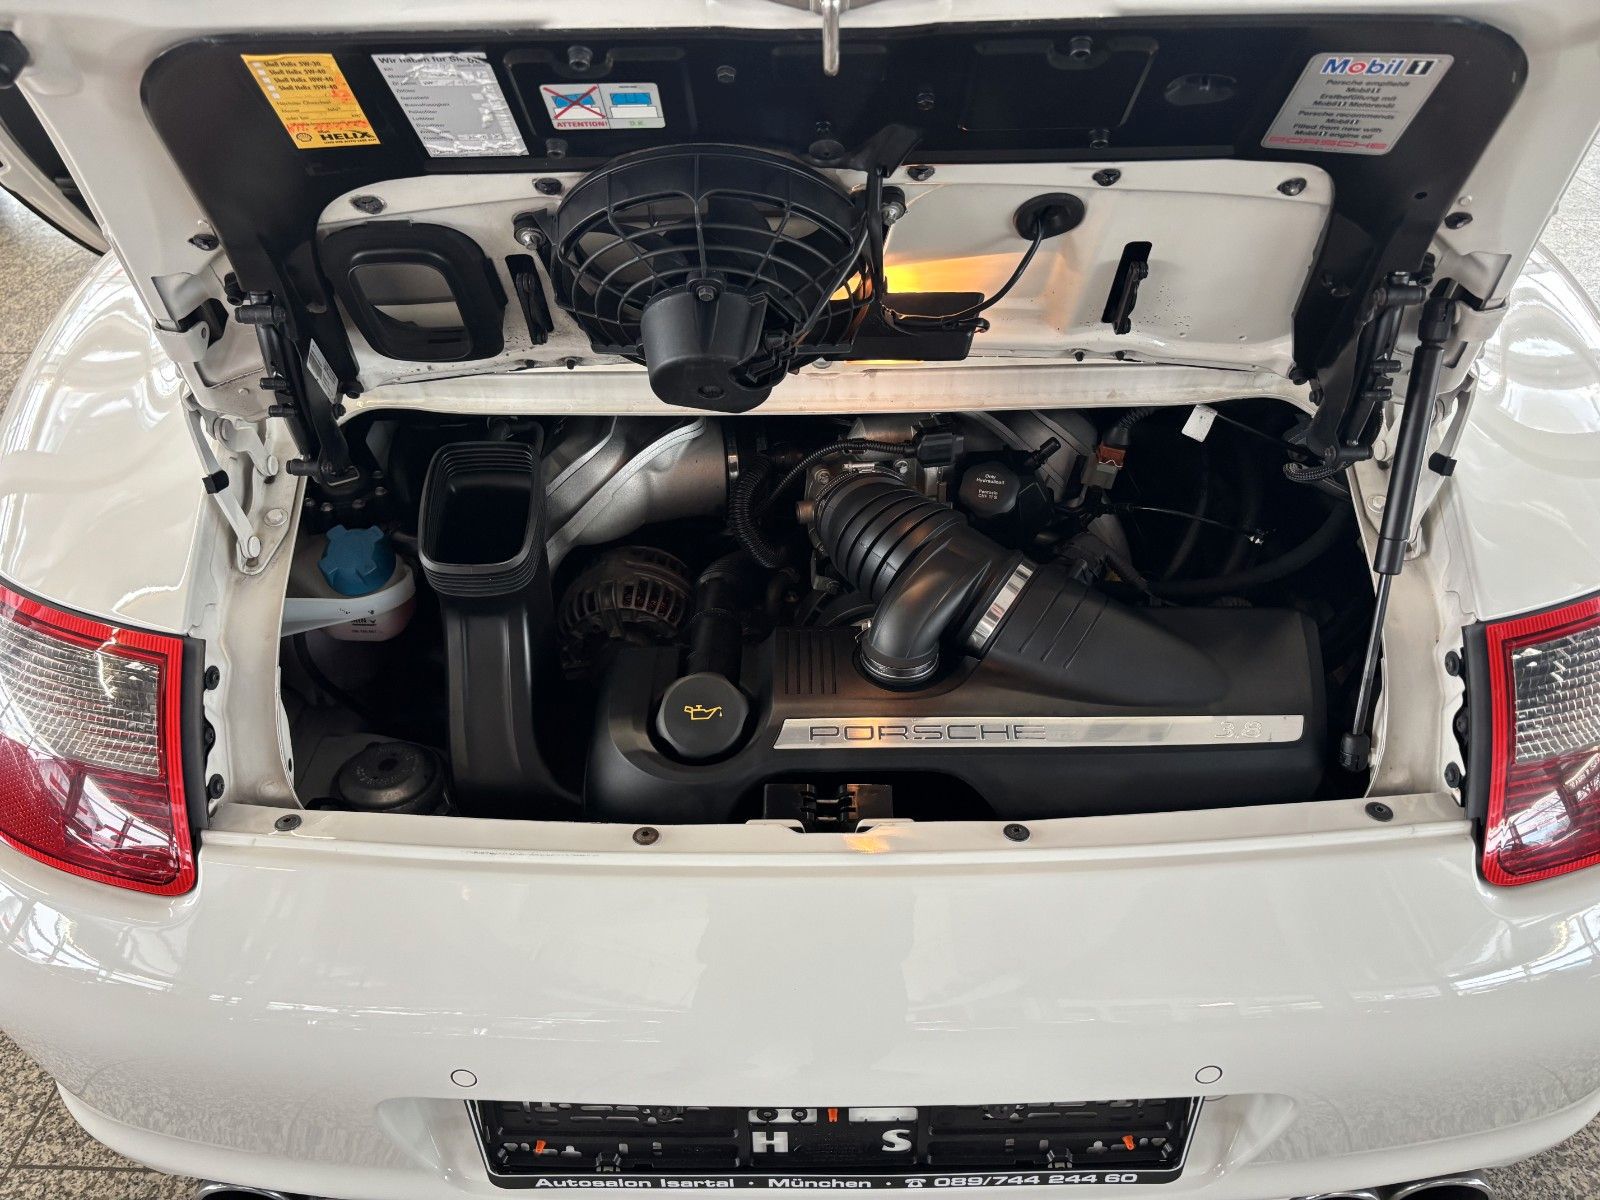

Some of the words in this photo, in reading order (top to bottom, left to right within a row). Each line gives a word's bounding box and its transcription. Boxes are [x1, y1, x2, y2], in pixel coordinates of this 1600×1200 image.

[1321, 58, 1404, 75] Mobil
[1326, 79, 1364, 87] Porsche
[1298, 110, 1335, 118] Porsche
[319, 131, 374, 142] HELIX
[1329, 131, 1357, 139] engine
[1268, 136, 1388, 149] PORSCHE
[808, 724, 1047, 742] PORSCHE
[752, 1131, 789, 1153] H
[881, 1129, 913, 1152] S
[535, 1178, 652, 1188] Autosalon
[660, 1178, 735, 1188] Isartal
[768, 1178, 872, 1188] München
[933, 1175, 1040, 1188] 089/744
[1048, 1174, 1099, 1185] 244
[1104, 1173, 1139, 1184] 60
